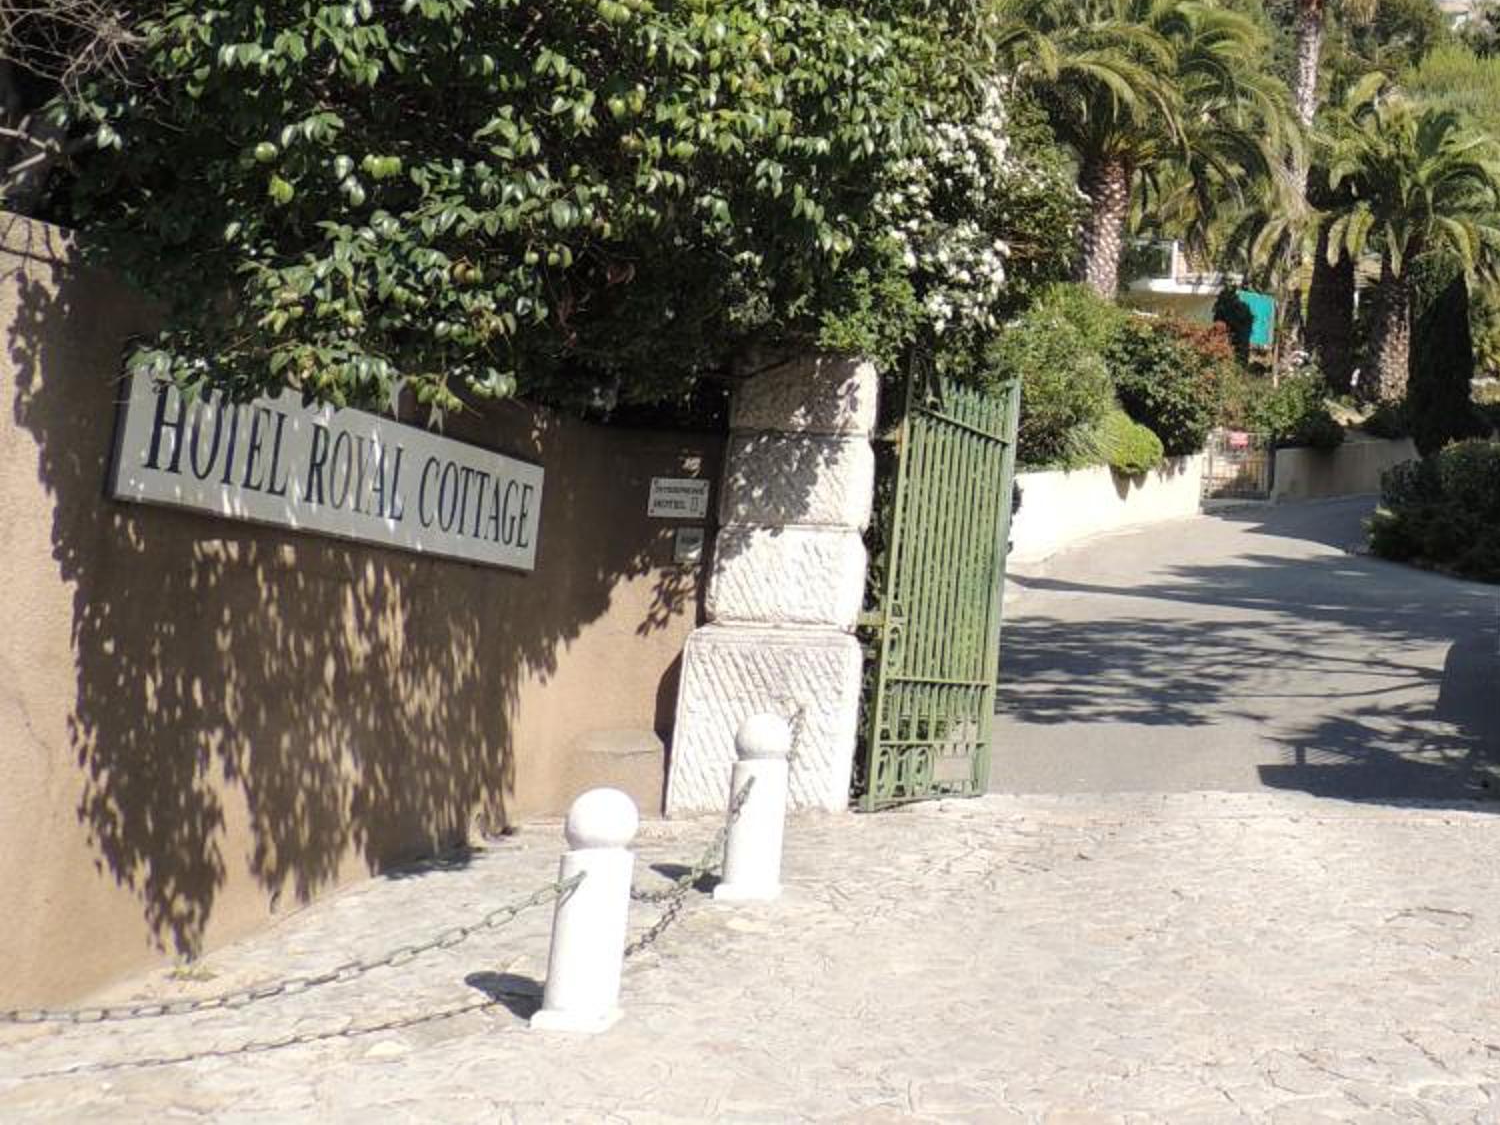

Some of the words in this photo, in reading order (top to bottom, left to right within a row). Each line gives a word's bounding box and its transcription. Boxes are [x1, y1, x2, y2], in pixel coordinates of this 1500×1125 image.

[143, 382, 288, 496] HOTEL
[304, 423, 405, 521] ROYAL
[418, 456, 534, 549] COTTAGE
